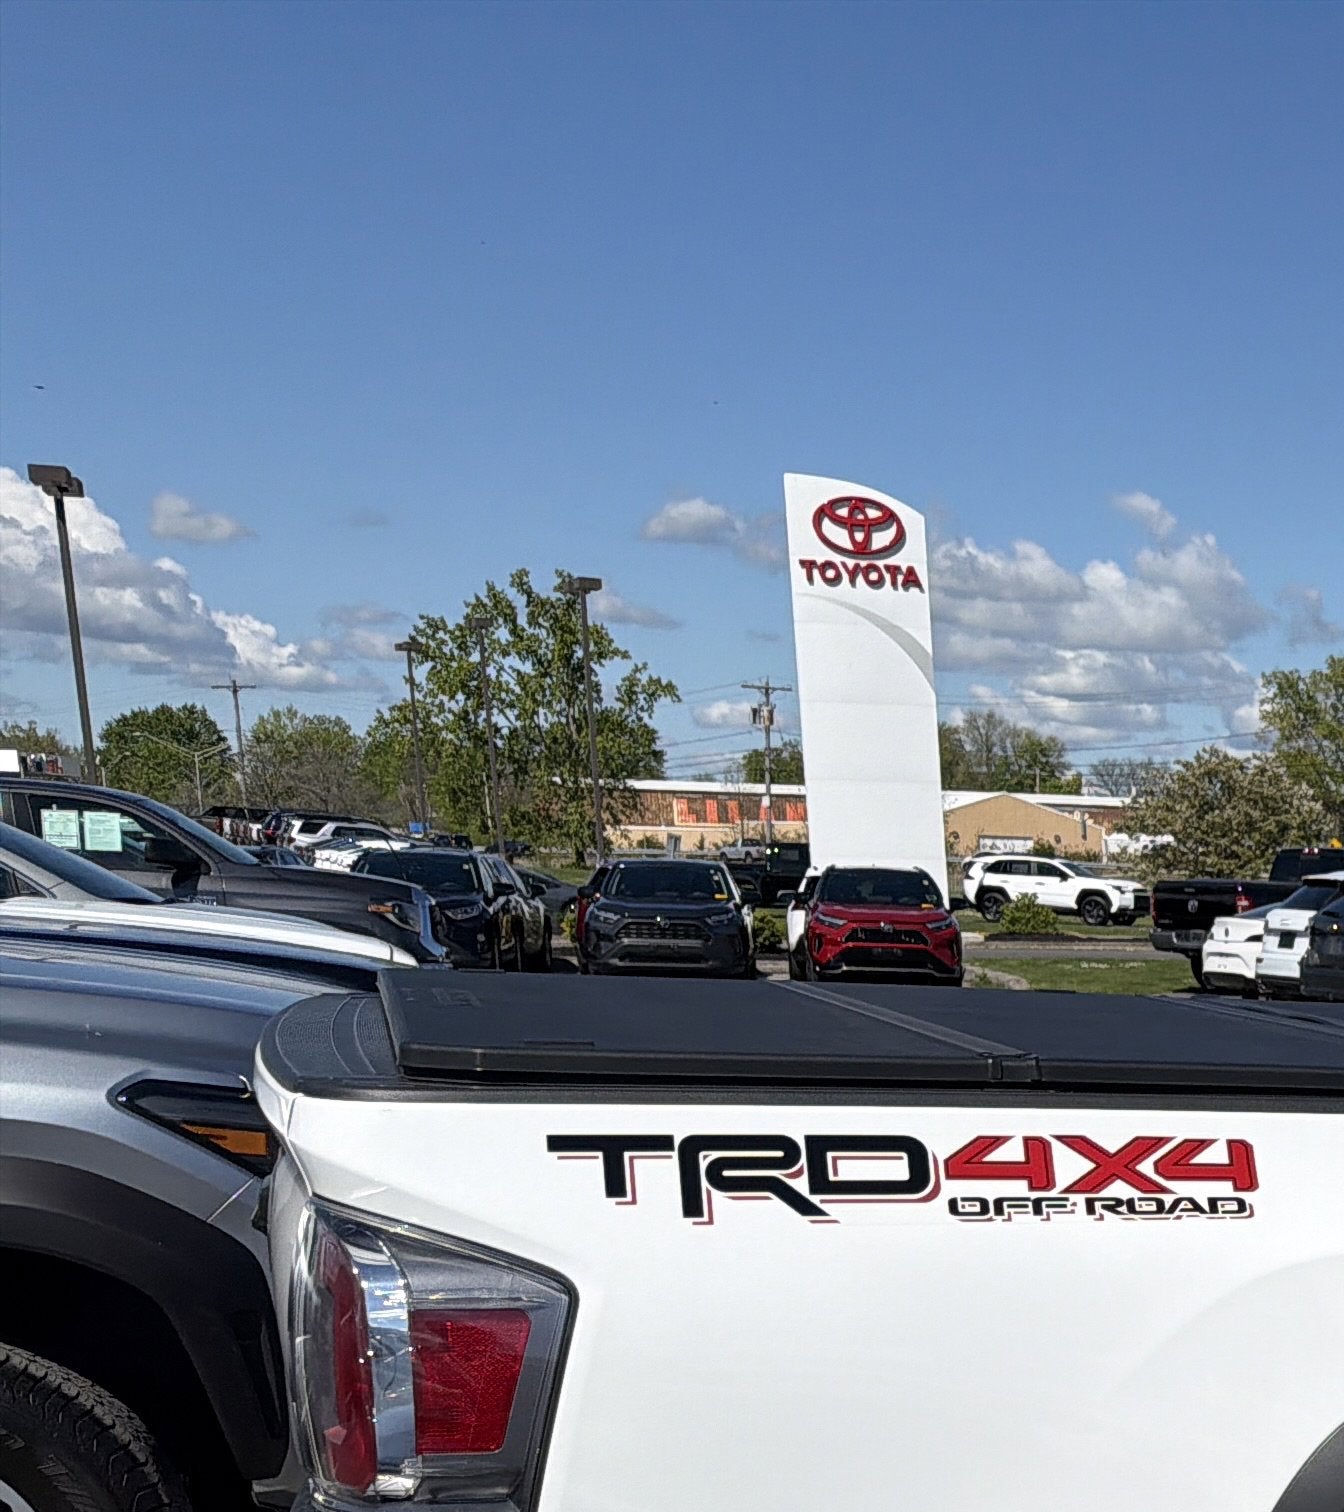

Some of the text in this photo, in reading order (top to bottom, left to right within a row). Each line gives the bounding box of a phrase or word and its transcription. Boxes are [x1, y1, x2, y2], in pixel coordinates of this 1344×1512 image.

[798, 558, 926, 594] TOYOTA
[546, 1134, 942, 1226] TRD
[948, 1196, 1256, 1223] OFF ROAD
